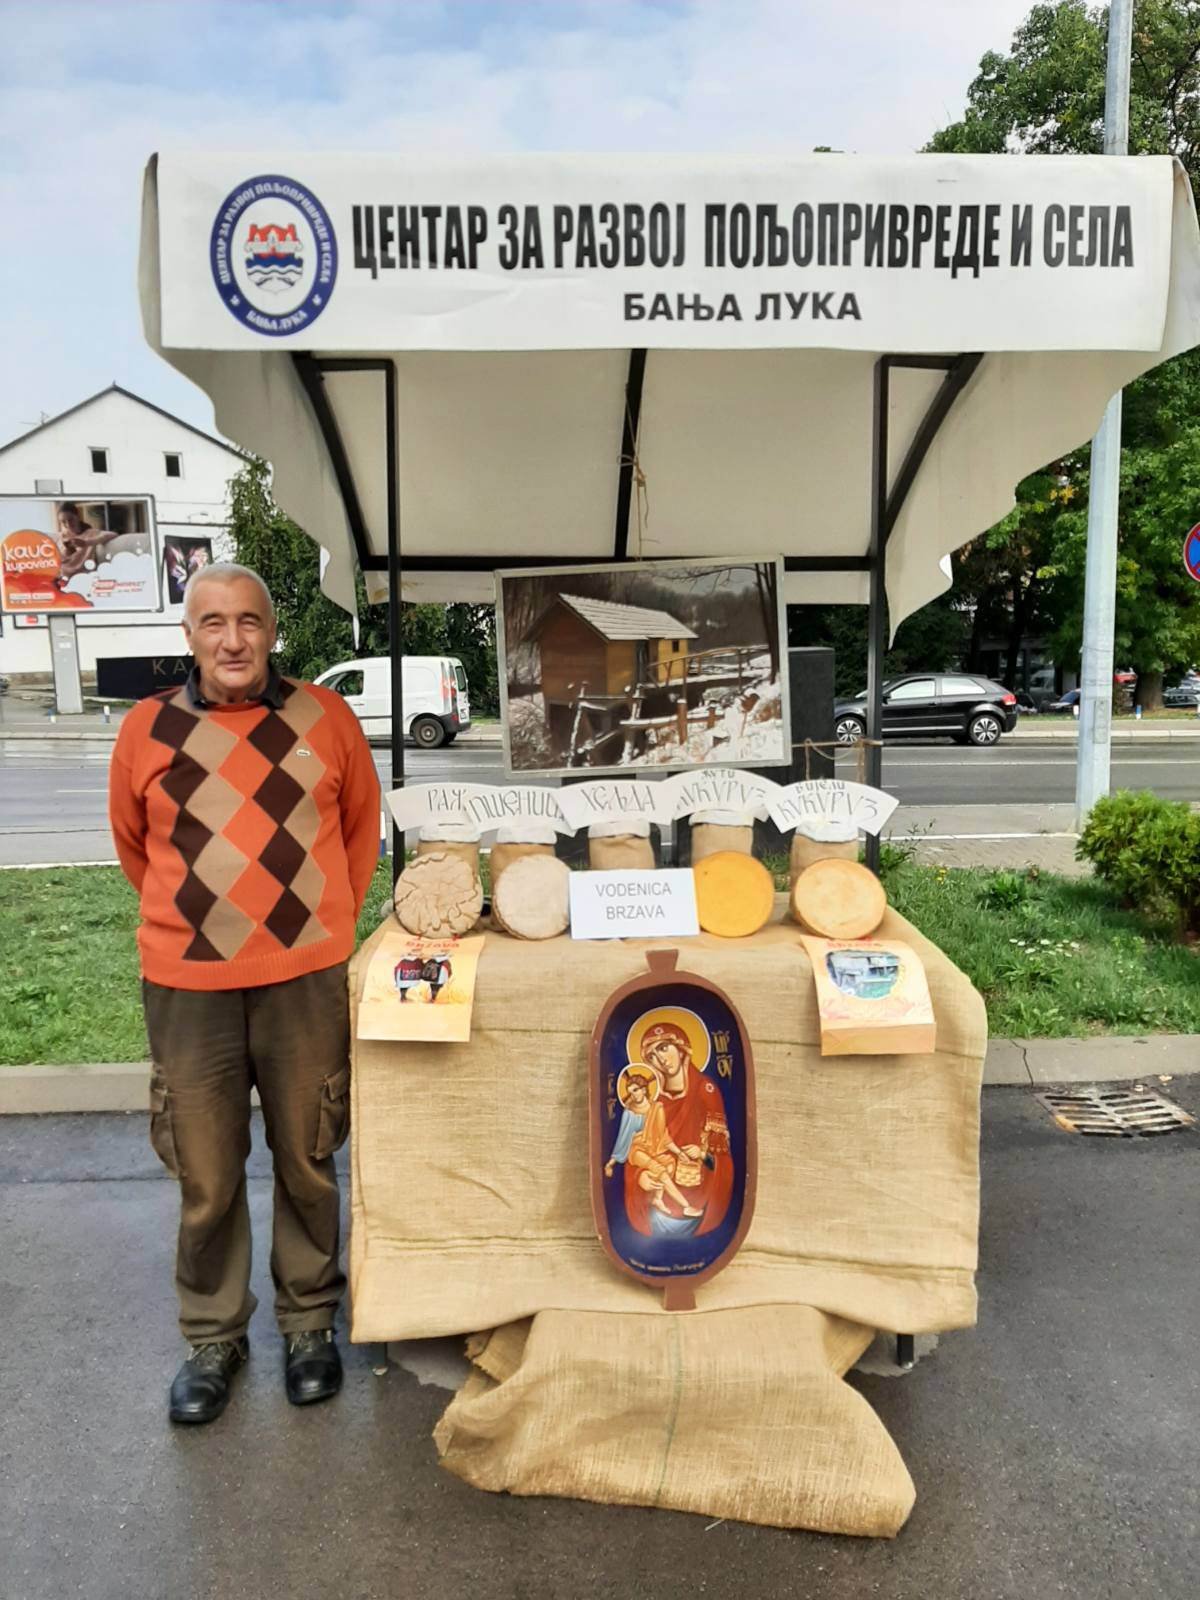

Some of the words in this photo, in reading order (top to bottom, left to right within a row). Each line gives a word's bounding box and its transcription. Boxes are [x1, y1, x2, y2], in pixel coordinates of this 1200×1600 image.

[352, 204, 488, 279] ЦЕНТАР
[498, 203, 545, 270] ЗА
[553, 202, 686, 269] РАЗВОЈ
[704, 202, 1001, 279] ПОЉОПРИВРЕДЕ
[1010, 204, 1033, 267] И
[1043, 204, 1134, 267] СЕЛА
[623, 292, 743, 321] БАЊА
[755, 292, 863, 321] ЛУКА
[3, 539, 54, 561] kauč
[4, 560, 58, 573] kupovina
[595, 882, 672, 897] VODENICA
[606, 905, 665, 920] BRZAVA
